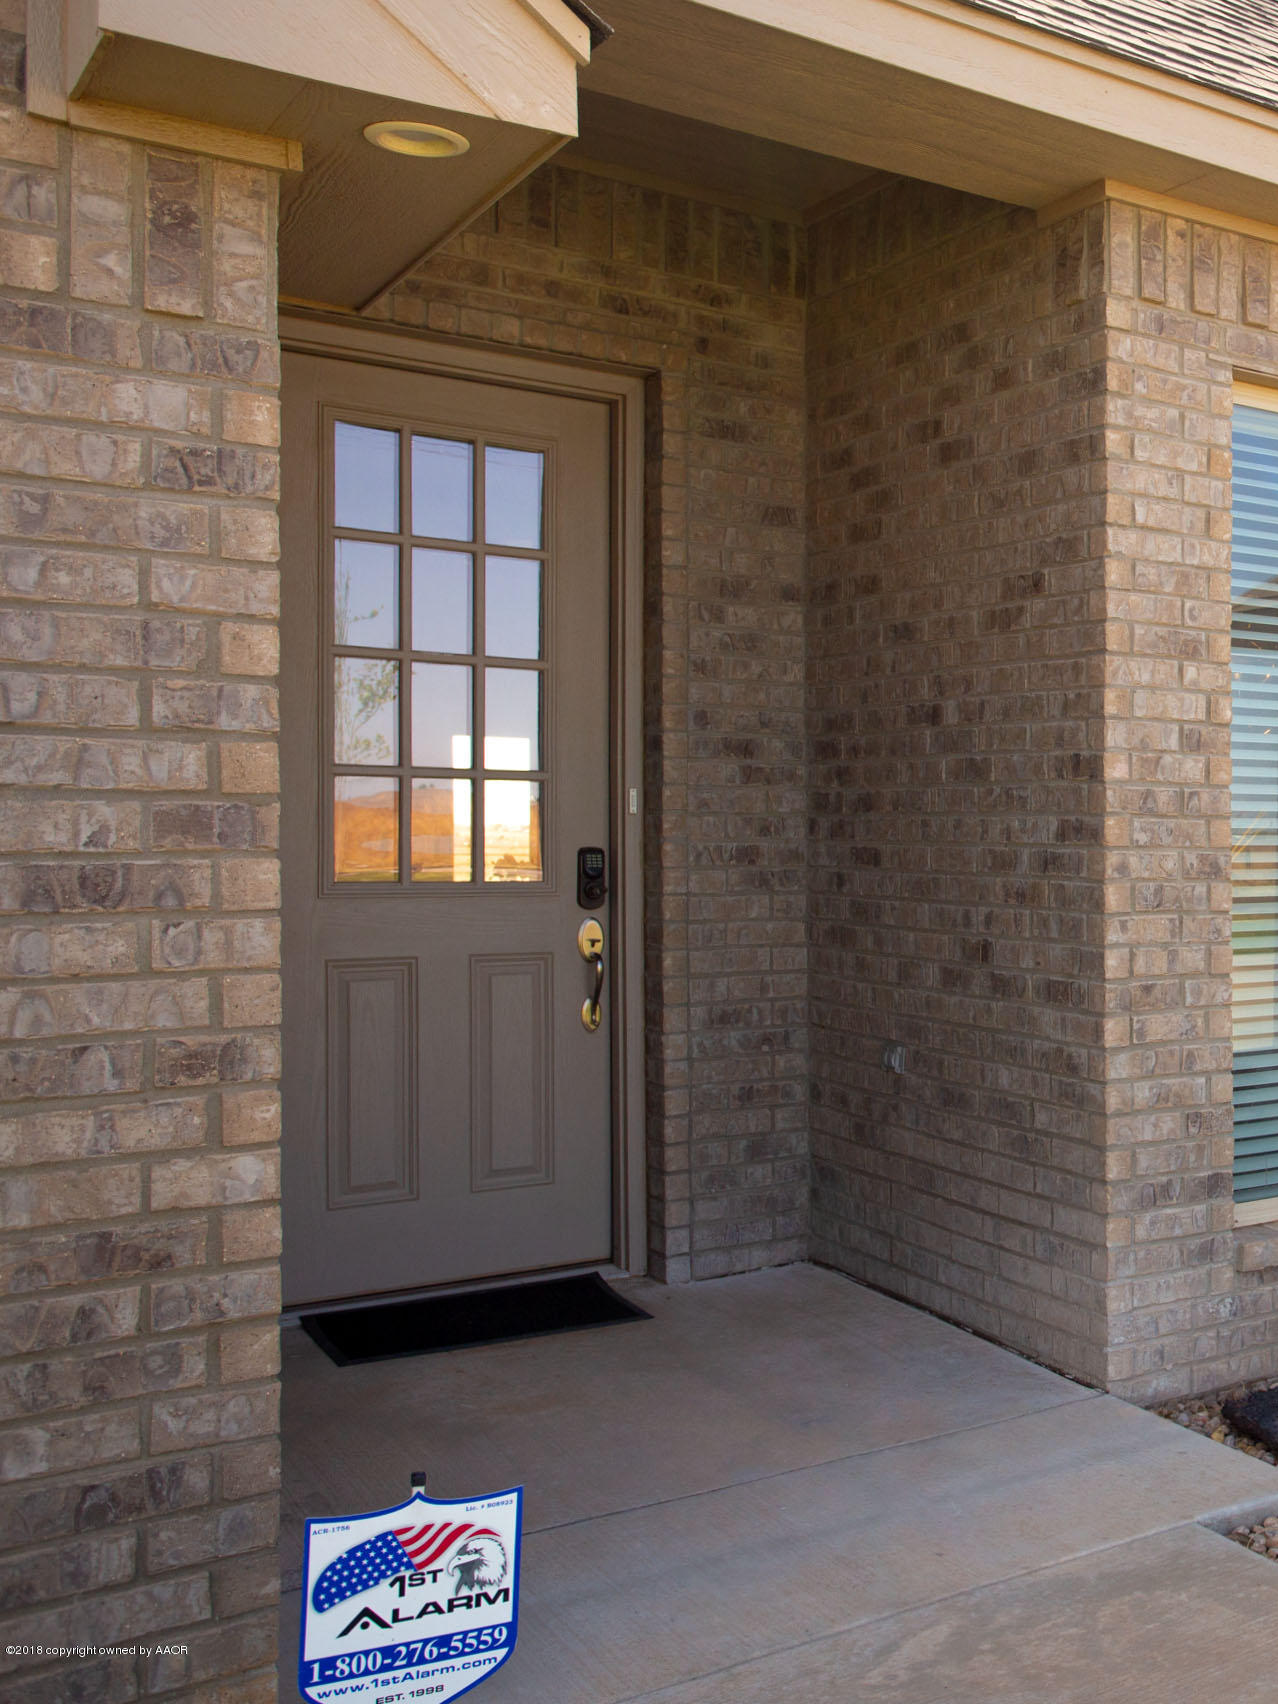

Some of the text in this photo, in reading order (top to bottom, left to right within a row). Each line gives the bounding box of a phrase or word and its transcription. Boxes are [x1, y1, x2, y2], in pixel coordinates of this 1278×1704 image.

[388, 1568, 444, 1597] 1ST
[336, 1587, 510, 1639] ALARM
[309, 1626, 508, 1683] 1-800-276-5559
[317, 1656, 498, 1699] www.1stAlarm.com
[376, 1684, 445, 1704] EST. 1998
